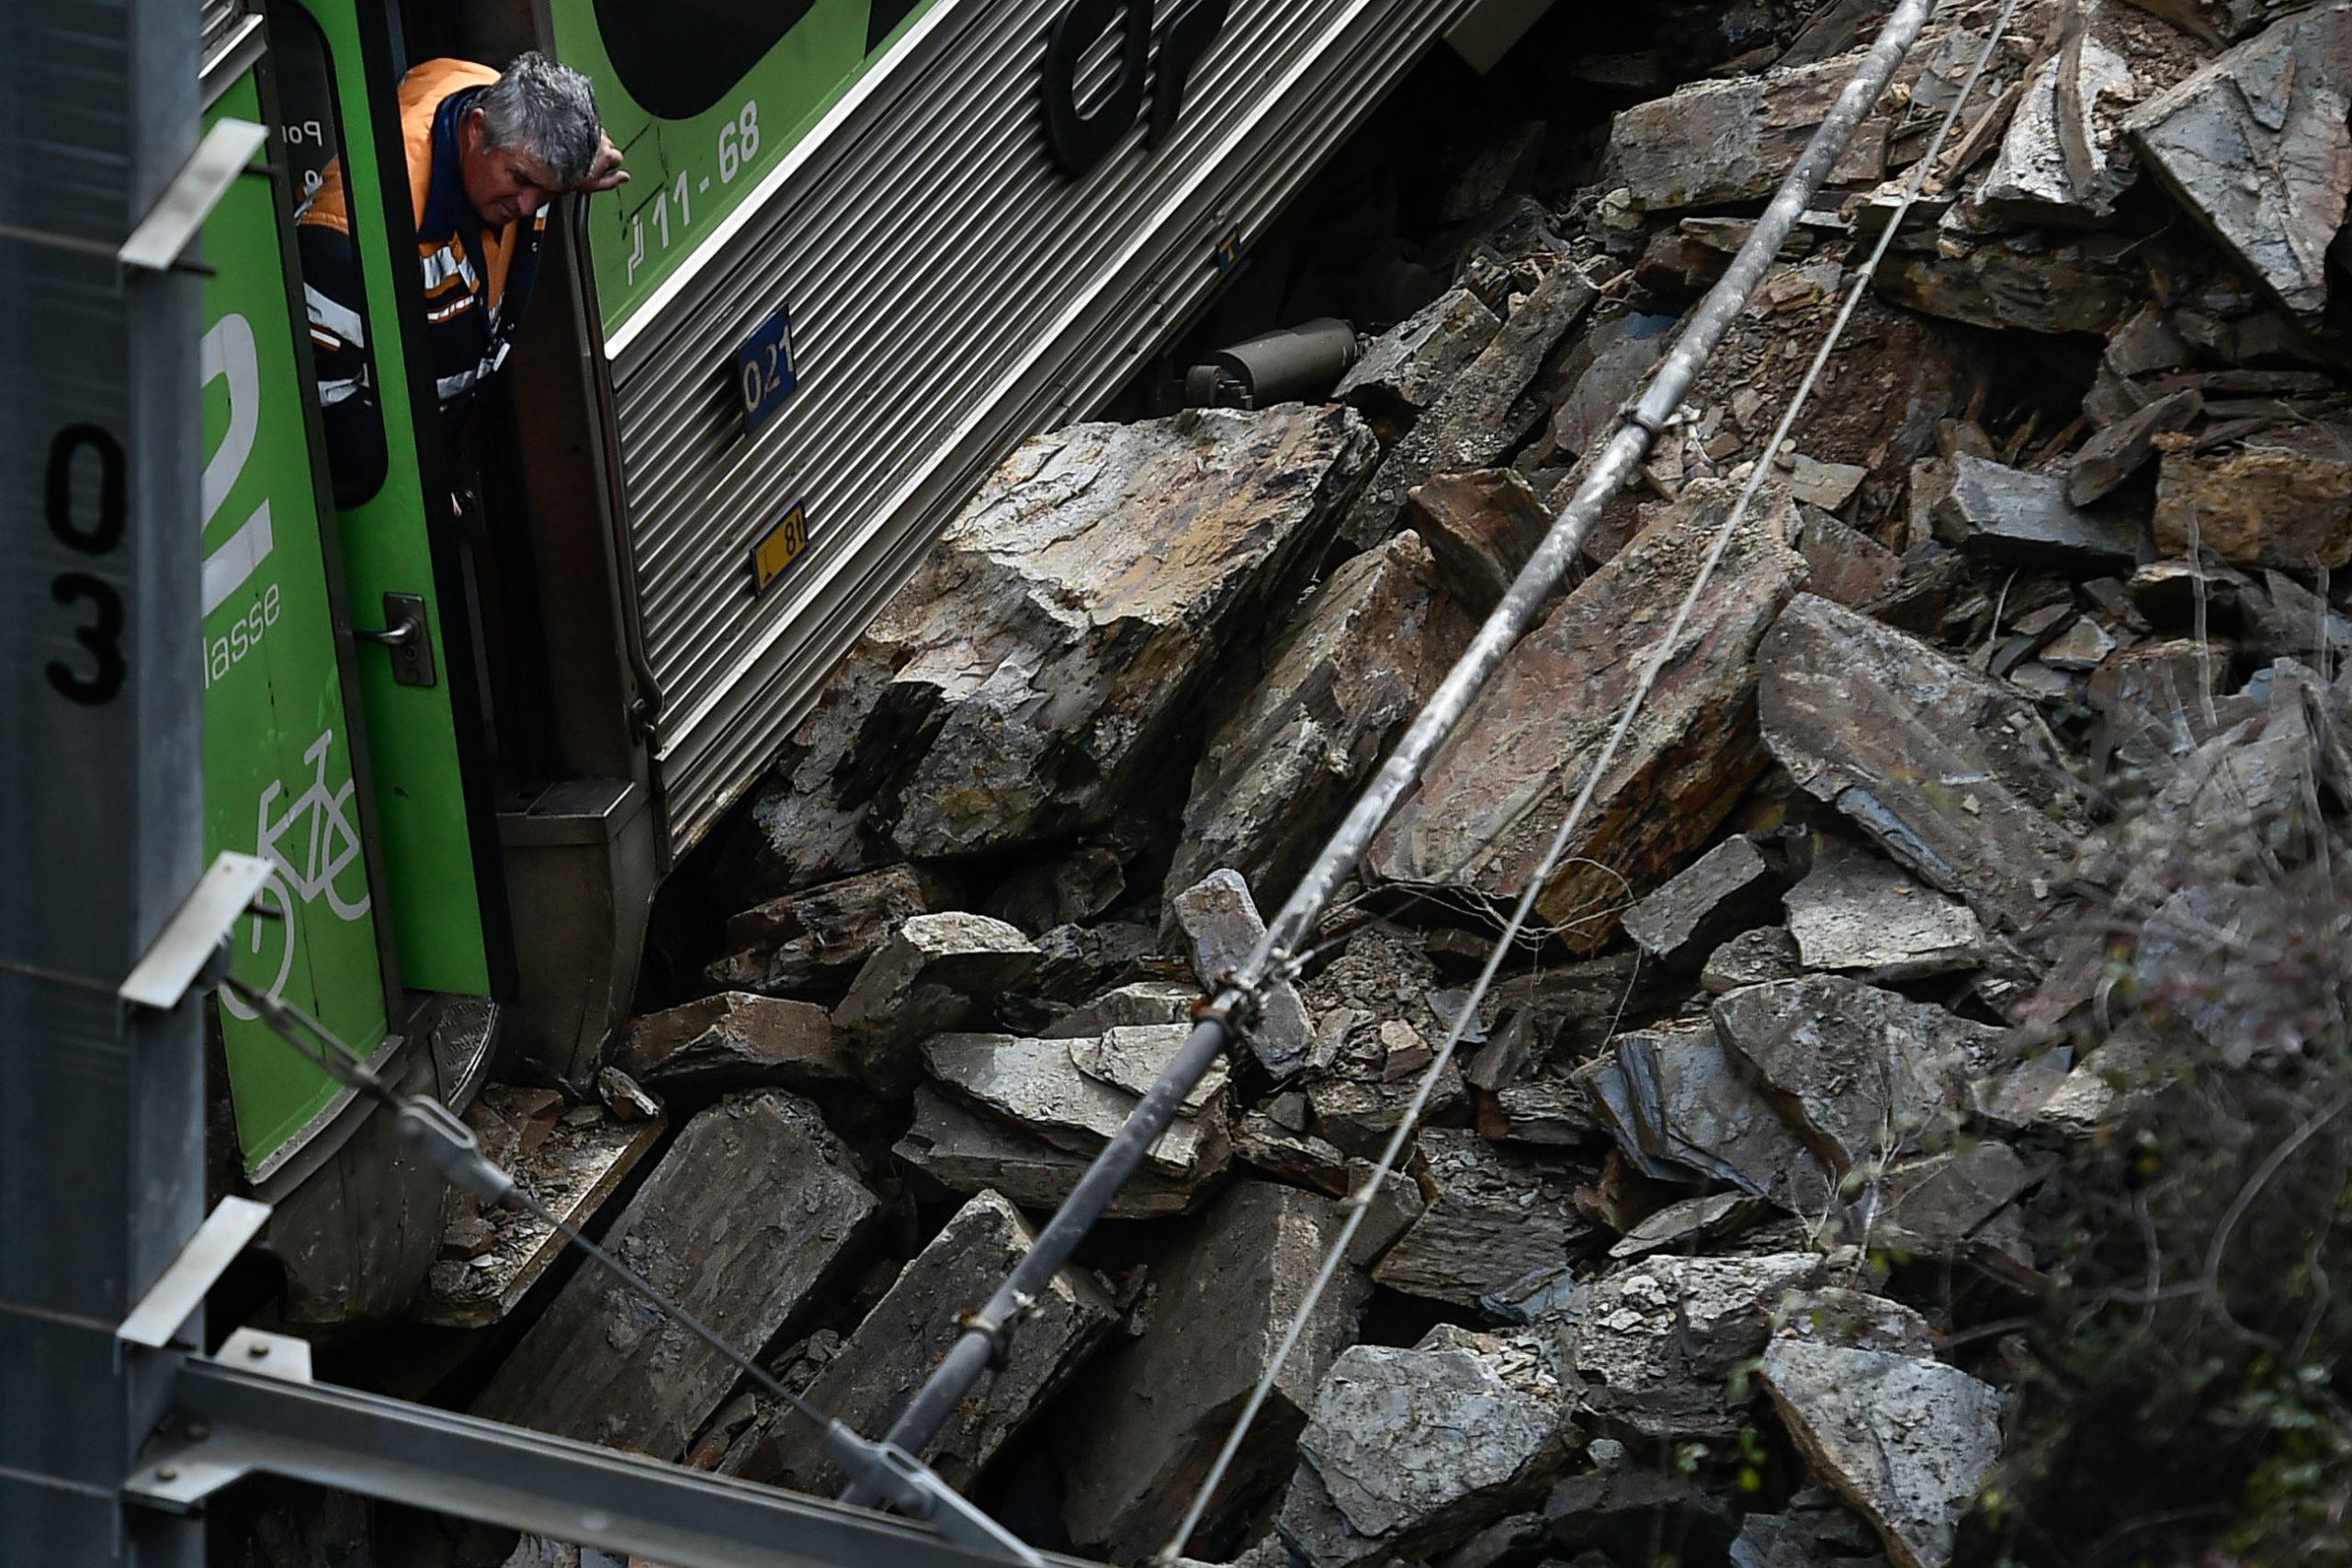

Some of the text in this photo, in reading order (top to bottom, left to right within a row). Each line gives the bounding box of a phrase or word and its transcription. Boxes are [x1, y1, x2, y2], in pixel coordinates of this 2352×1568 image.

[743, 323, 794, 412] 021
[201, 312, 274, 619] 2
[202, 583, 279, 690] lasse
